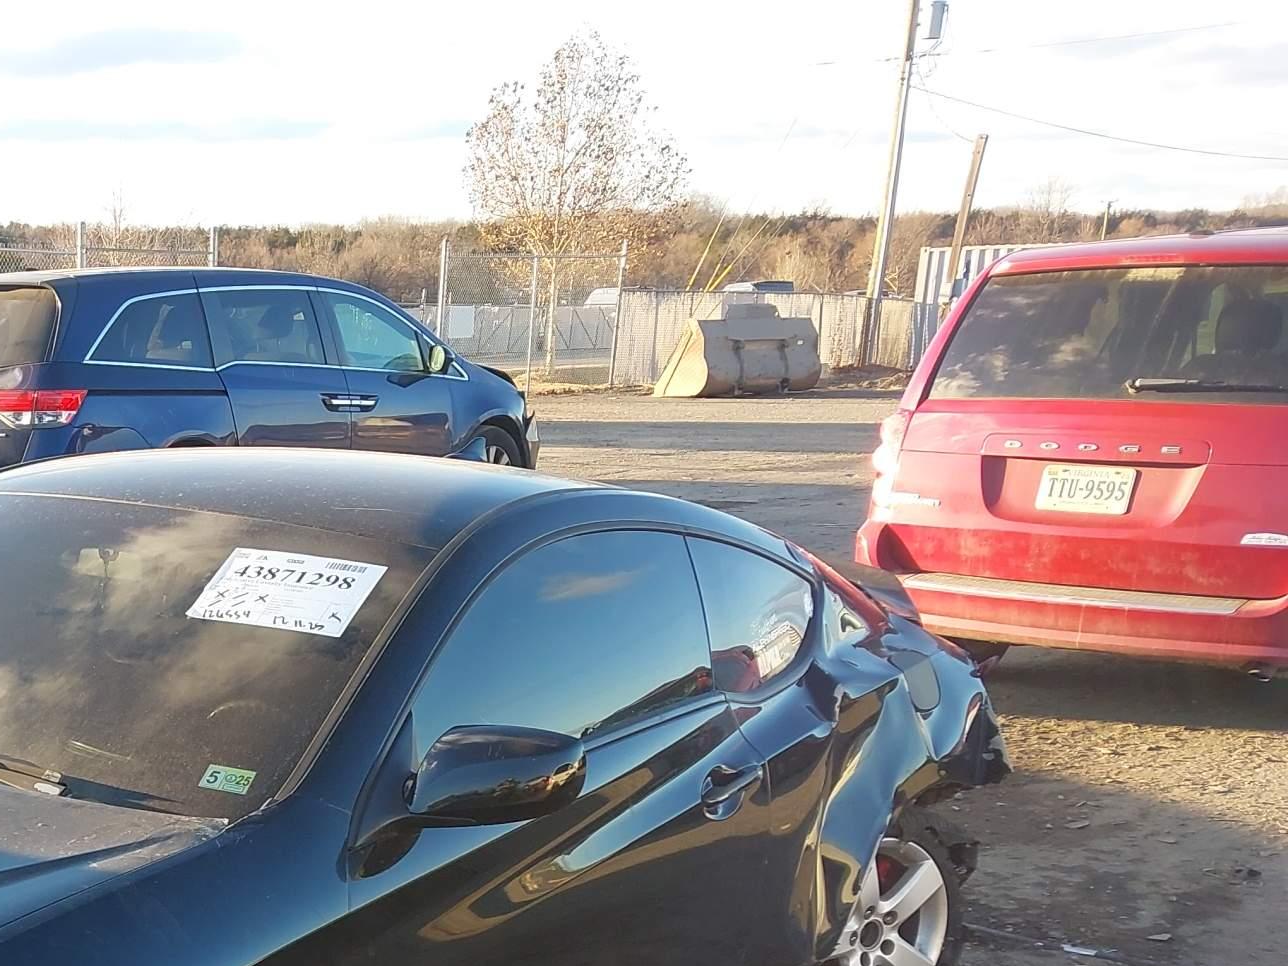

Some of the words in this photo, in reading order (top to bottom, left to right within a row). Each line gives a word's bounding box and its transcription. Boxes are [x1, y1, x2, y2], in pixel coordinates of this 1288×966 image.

[1004, 440, 1183, 455] DODGE
[1047, 478, 1129, 502] TTU-9595
[233, 564, 357, 591] 43871298
[205, 770, 221, 784] 5
[235, 775, 252, 787] 25
